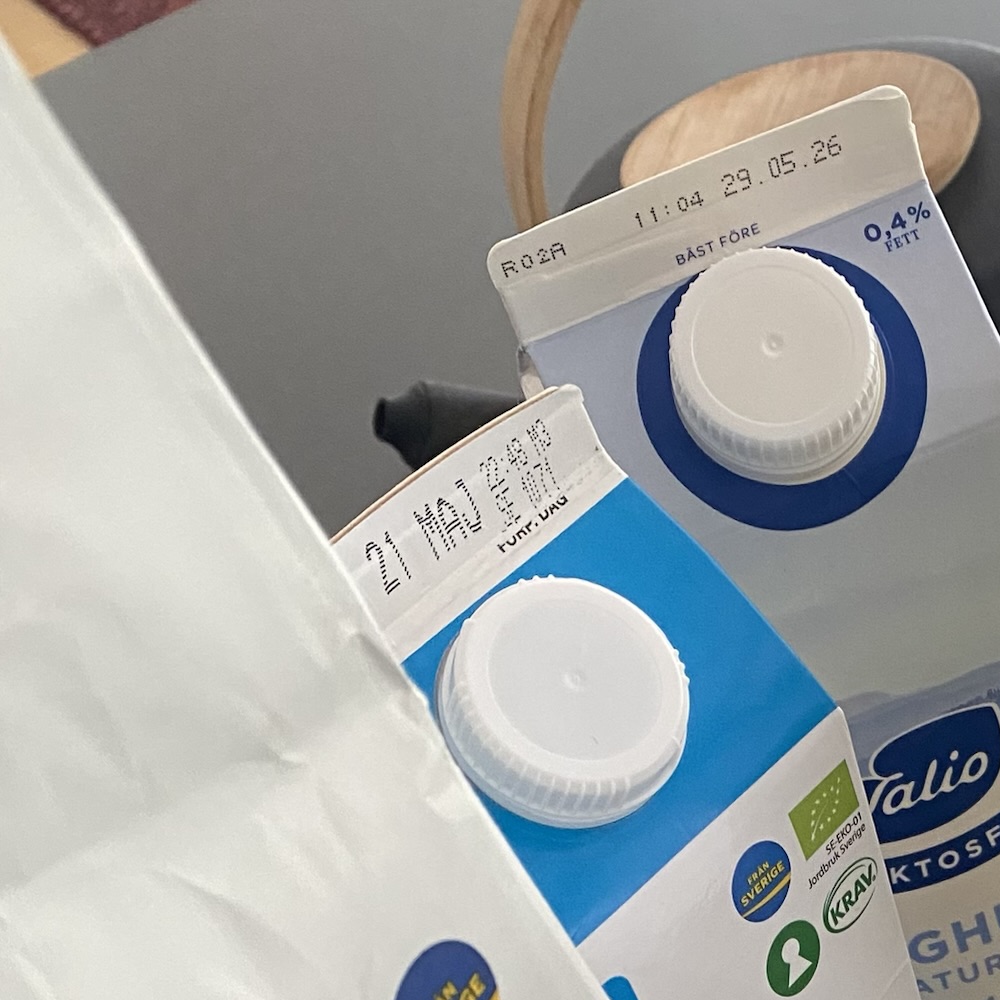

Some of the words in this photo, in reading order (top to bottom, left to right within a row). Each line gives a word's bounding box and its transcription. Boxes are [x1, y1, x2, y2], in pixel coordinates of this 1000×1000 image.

[635, 190, 704, 228] 11:04
[721, 135, 842, 198] 29.05.26
[676, 238, 714, 266] BÄST
[718, 222, 762, 252] FÖRE
[863, 202, 931, 243] 0,4%
[884, 228, 921, 253] FETT
[501, 242, 567, 278] R02A
[365, 530, 412, 595] 21
[413, 478, 483, 560] MAJ
[808, 852, 841, 890] Jordbruk
[839, 822, 867, 855] Sverige
[825, 811, 863, 856] SE-EKO-01
[740, 860, 785, 907] SVERIGE
[747, 861, 770, 886] FRÅN
[830, 862, 875, 927] KRAV
